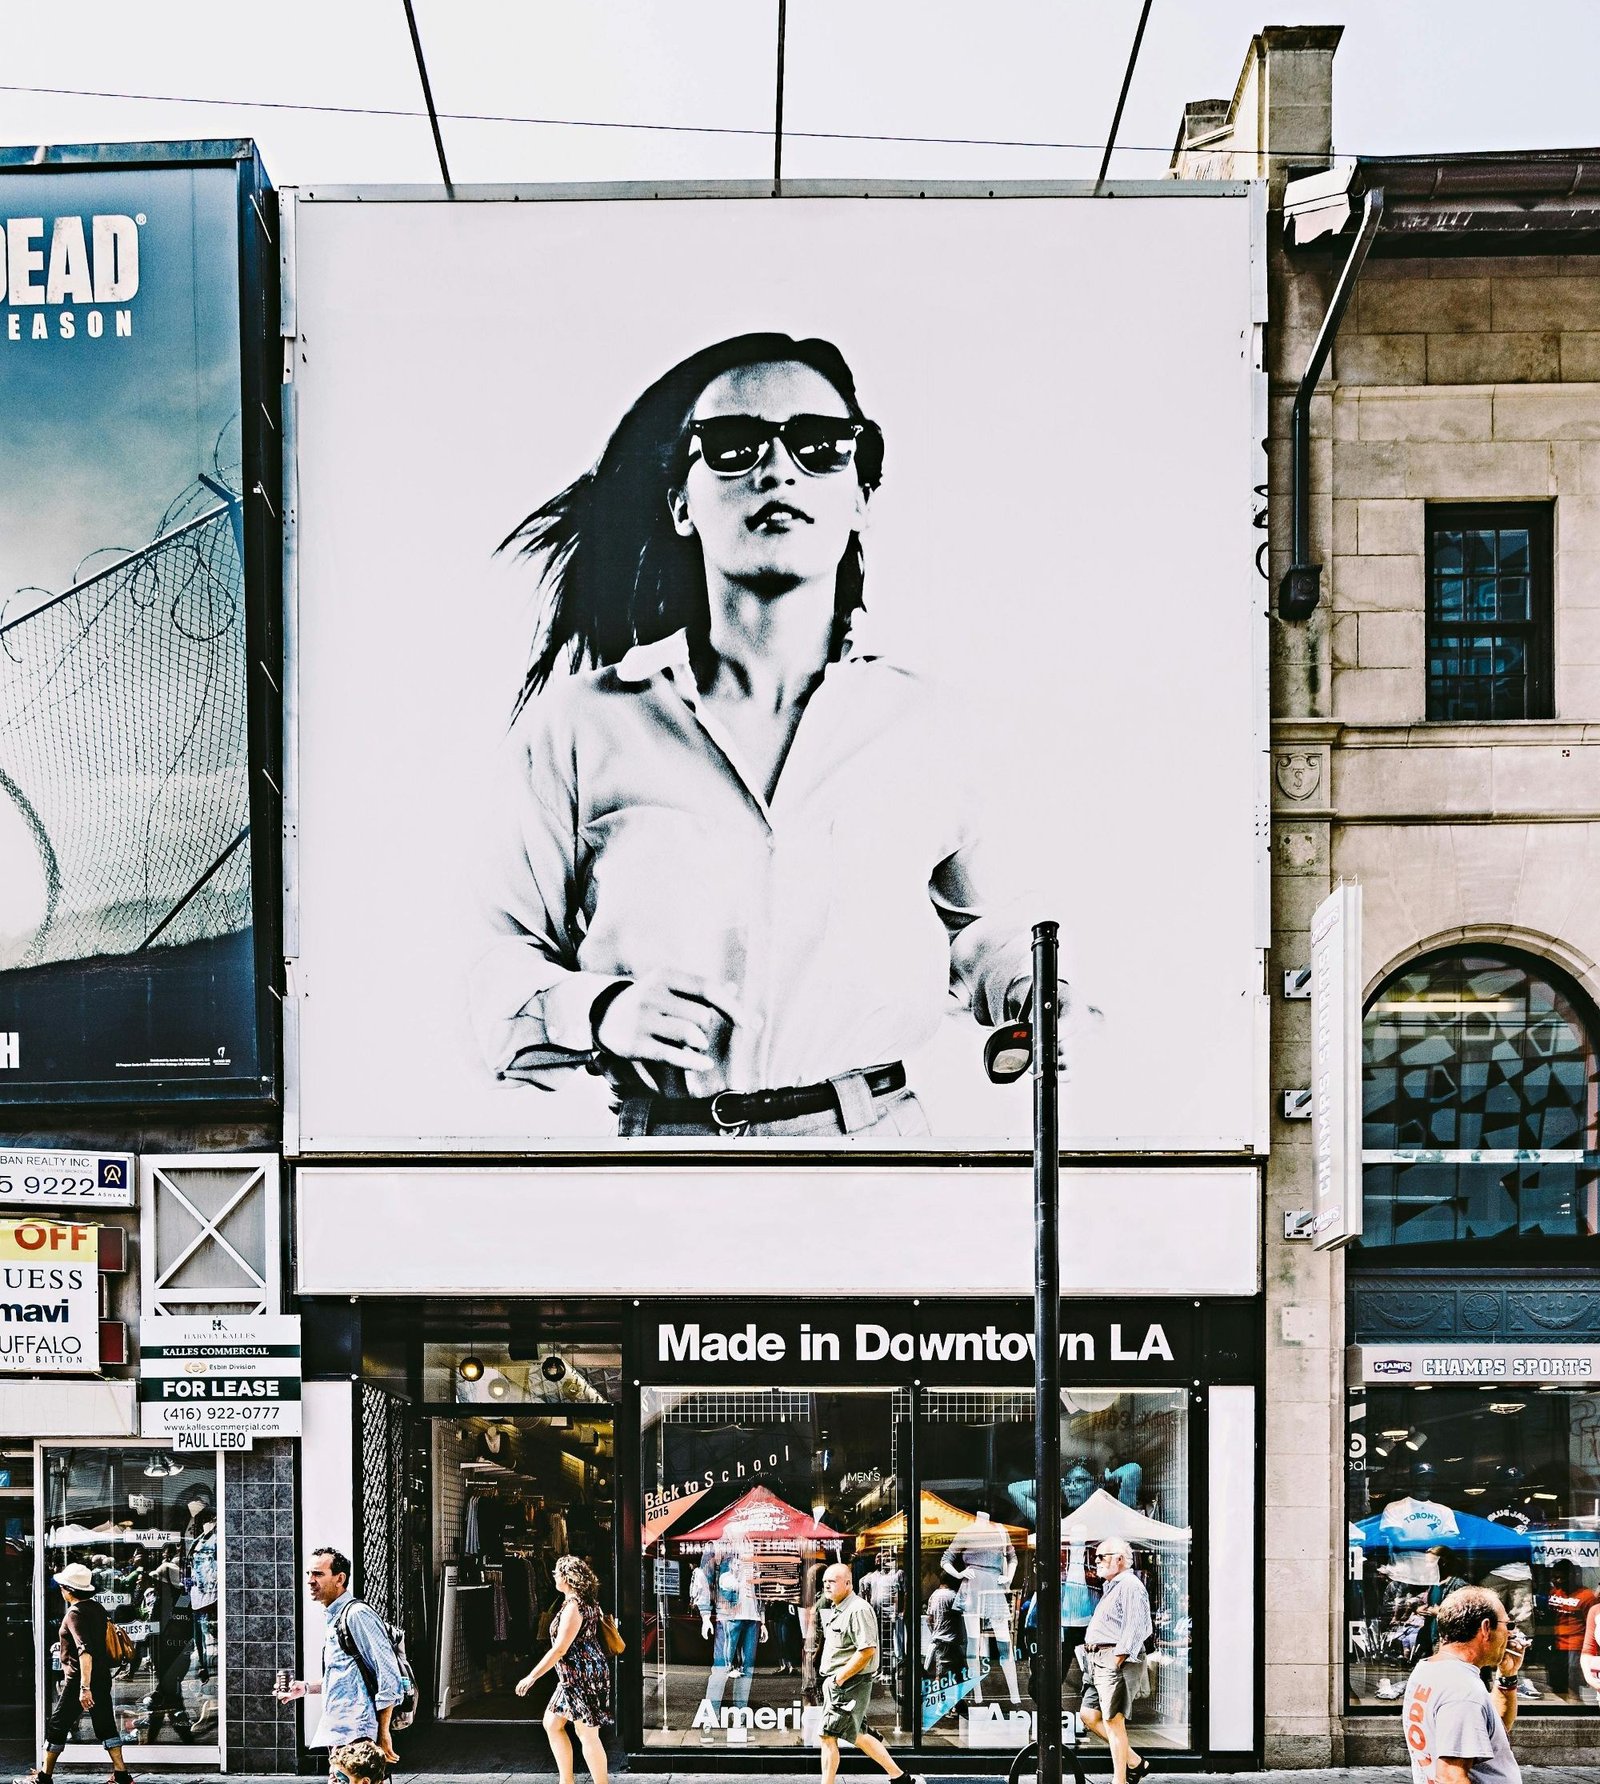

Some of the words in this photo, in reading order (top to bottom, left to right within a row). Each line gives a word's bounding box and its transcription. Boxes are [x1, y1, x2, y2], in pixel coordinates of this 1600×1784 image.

[0, 215, 139, 305] EAD
[27, 1156, 66, 1166] REALTY
[70, 1158, 92, 1168] INC.
[24, 1176, 95, 1196] 9222
[14, 1223, 88, 1251] OFF
[4, 1269, 83, 1290] UESS
[659, 1323, 786, 1361] Made
[800, 1323, 840, 1361] in
[1110, 1323, 1175, 1361] LA
[162, 1348, 199, 1356] KALLES
[200, 1347, 270, 1356] COMMERCIAL
[36, 1356, 83, 1364] BITTON
[1375, 1362, 1411, 1371] CHAMPS
[1421, 1358, 1506, 1375] CHAMPS
[1513, 1358, 1592, 1375] SPORTS
[162, 1381, 206, 1397] FOR
[211, 1380, 280, 1397] LEASE
[163, 1407, 202, 1421] (416)
[207, 1407, 280, 1420] 922-0777
[164, 1423, 280, 1431] www.kallescommercial.com
[178, 1432, 209, 1448] PAUL
[213, 1432, 246, 1448] LEBO
[644, 1483, 680, 1510] Back
[684, 1480, 699, 1495] to
[704, 1445, 789, 1489] School
[847, 1470, 880, 1482] MEN'S
[647, 1506, 669, 1521] 2015
[1404, 1512, 1442, 1526] TORONTO
[921, 1670, 957, 1694] Back
[925, 1691, 946, 1708] 2015
